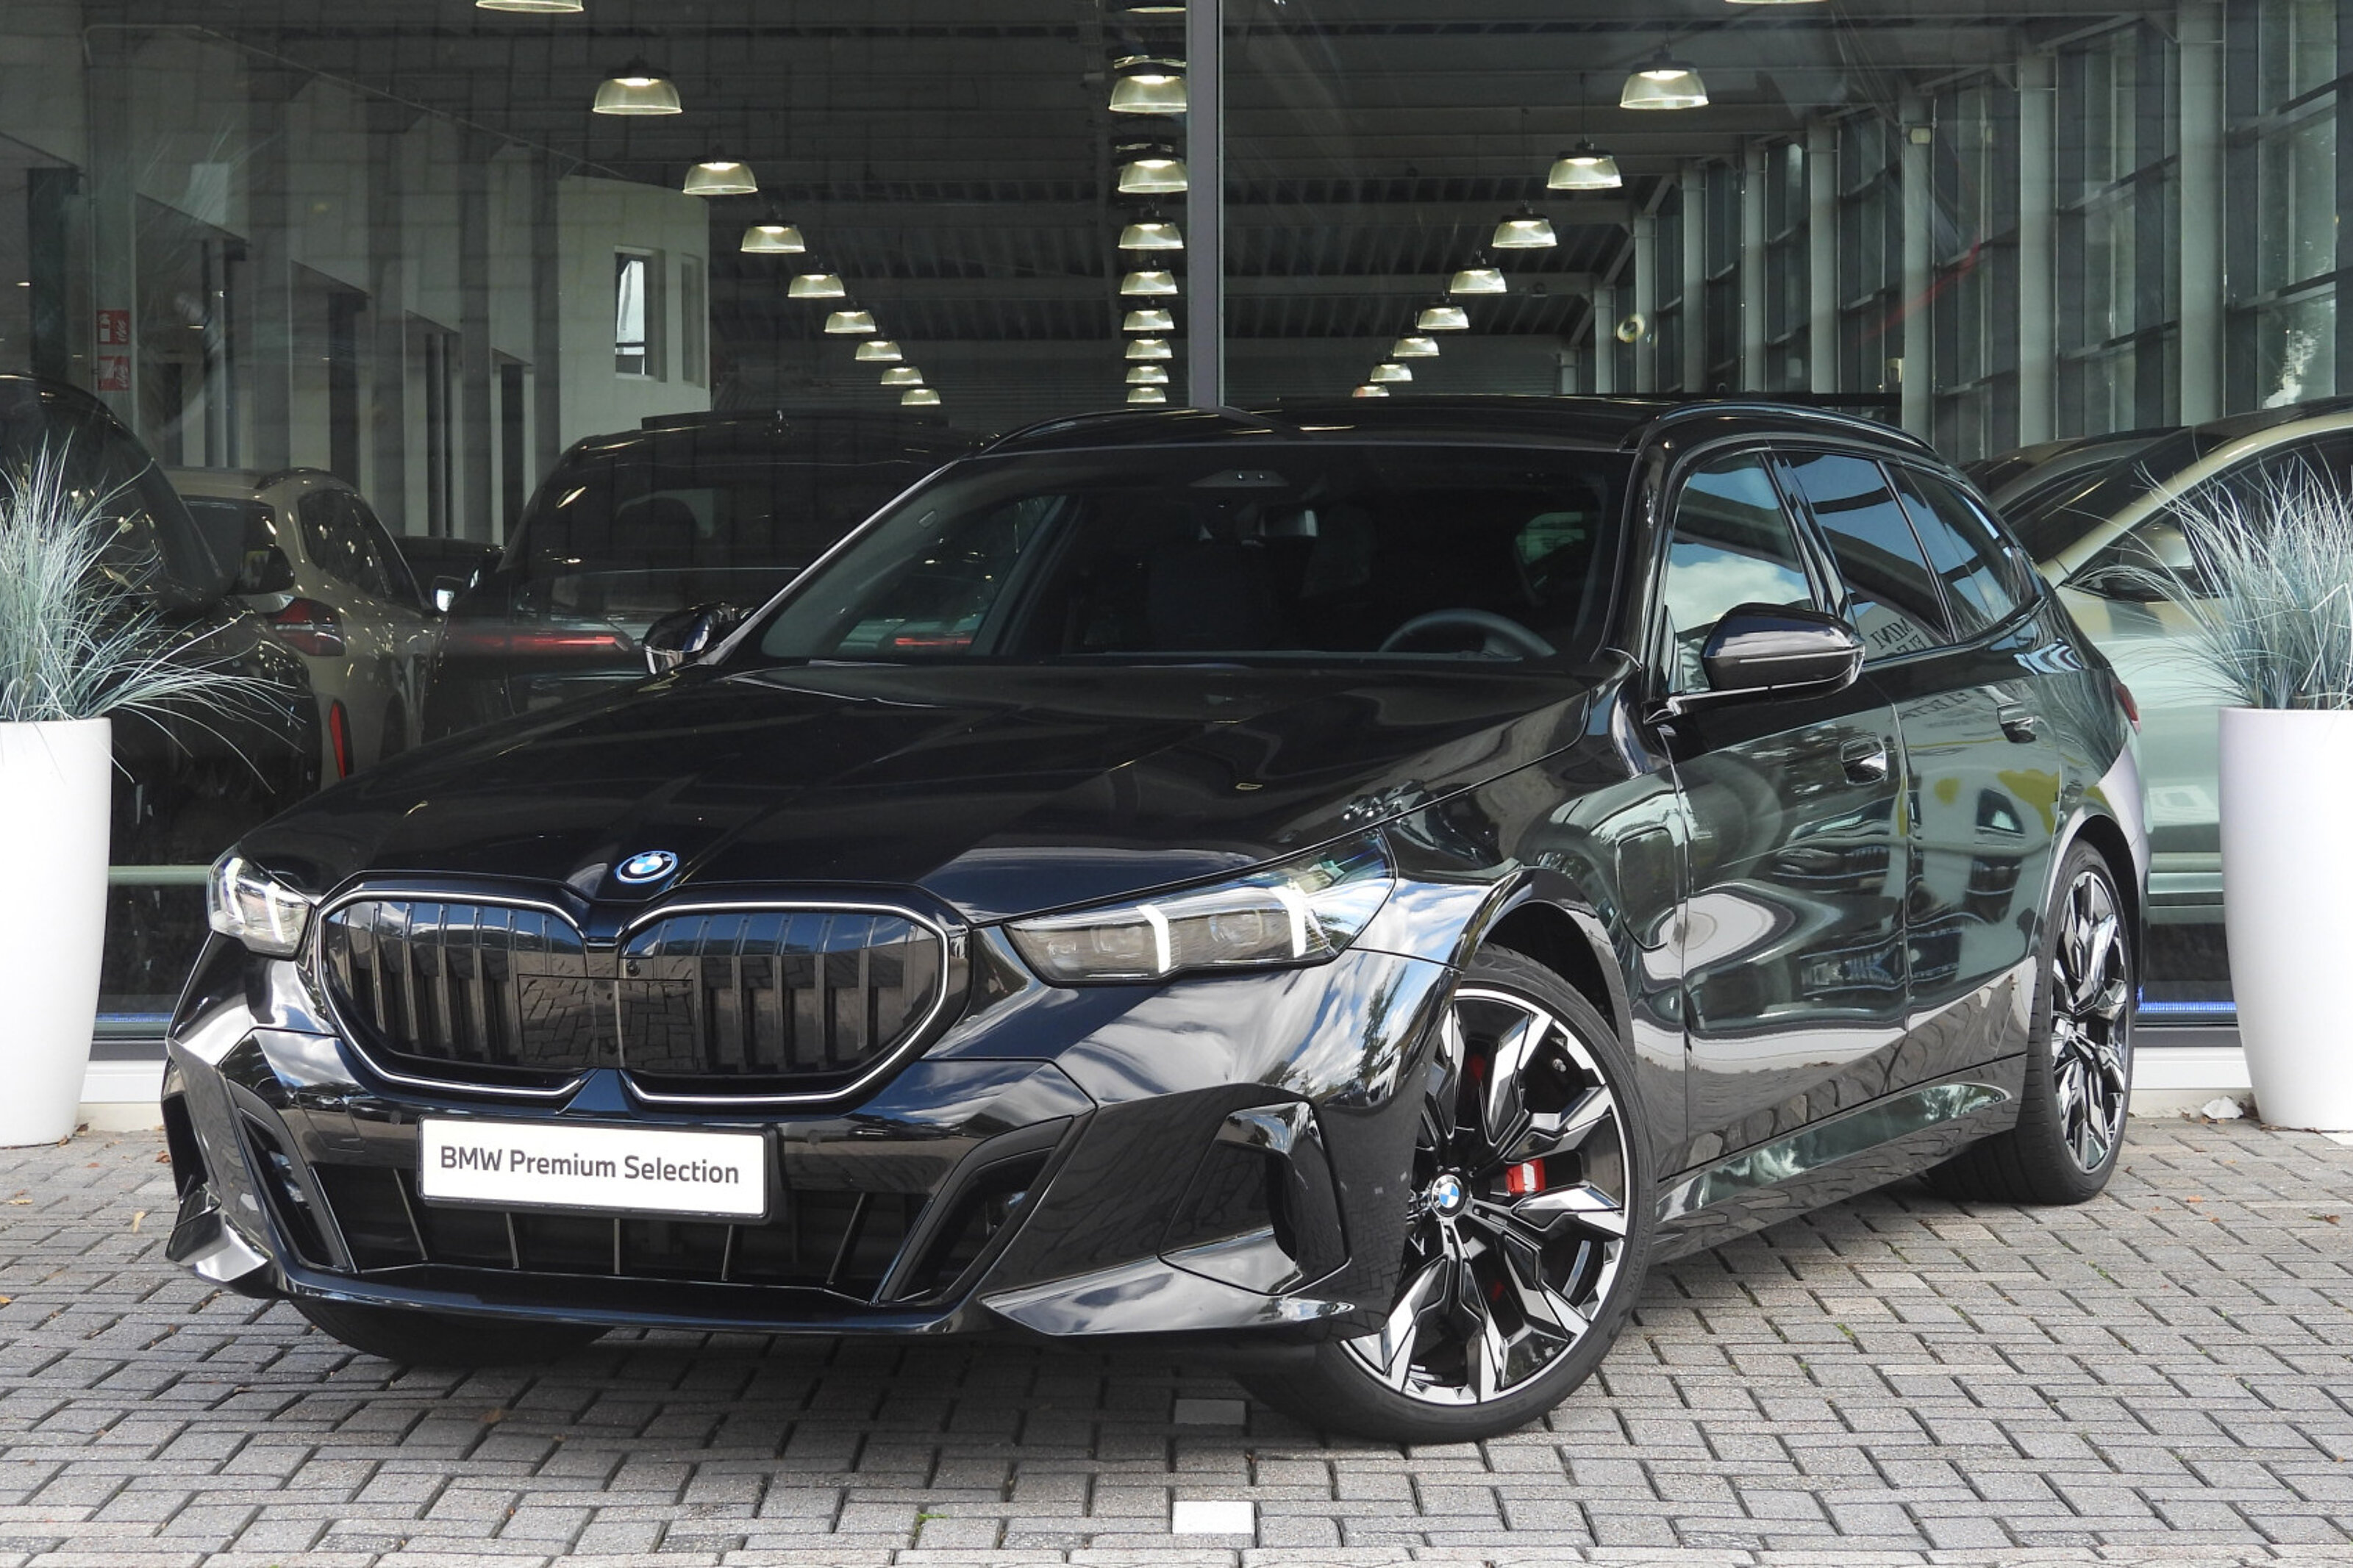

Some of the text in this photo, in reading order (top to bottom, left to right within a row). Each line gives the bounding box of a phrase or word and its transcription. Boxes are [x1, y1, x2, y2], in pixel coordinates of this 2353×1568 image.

[440, 1145, 739, 1184] BMW Premium Selection
